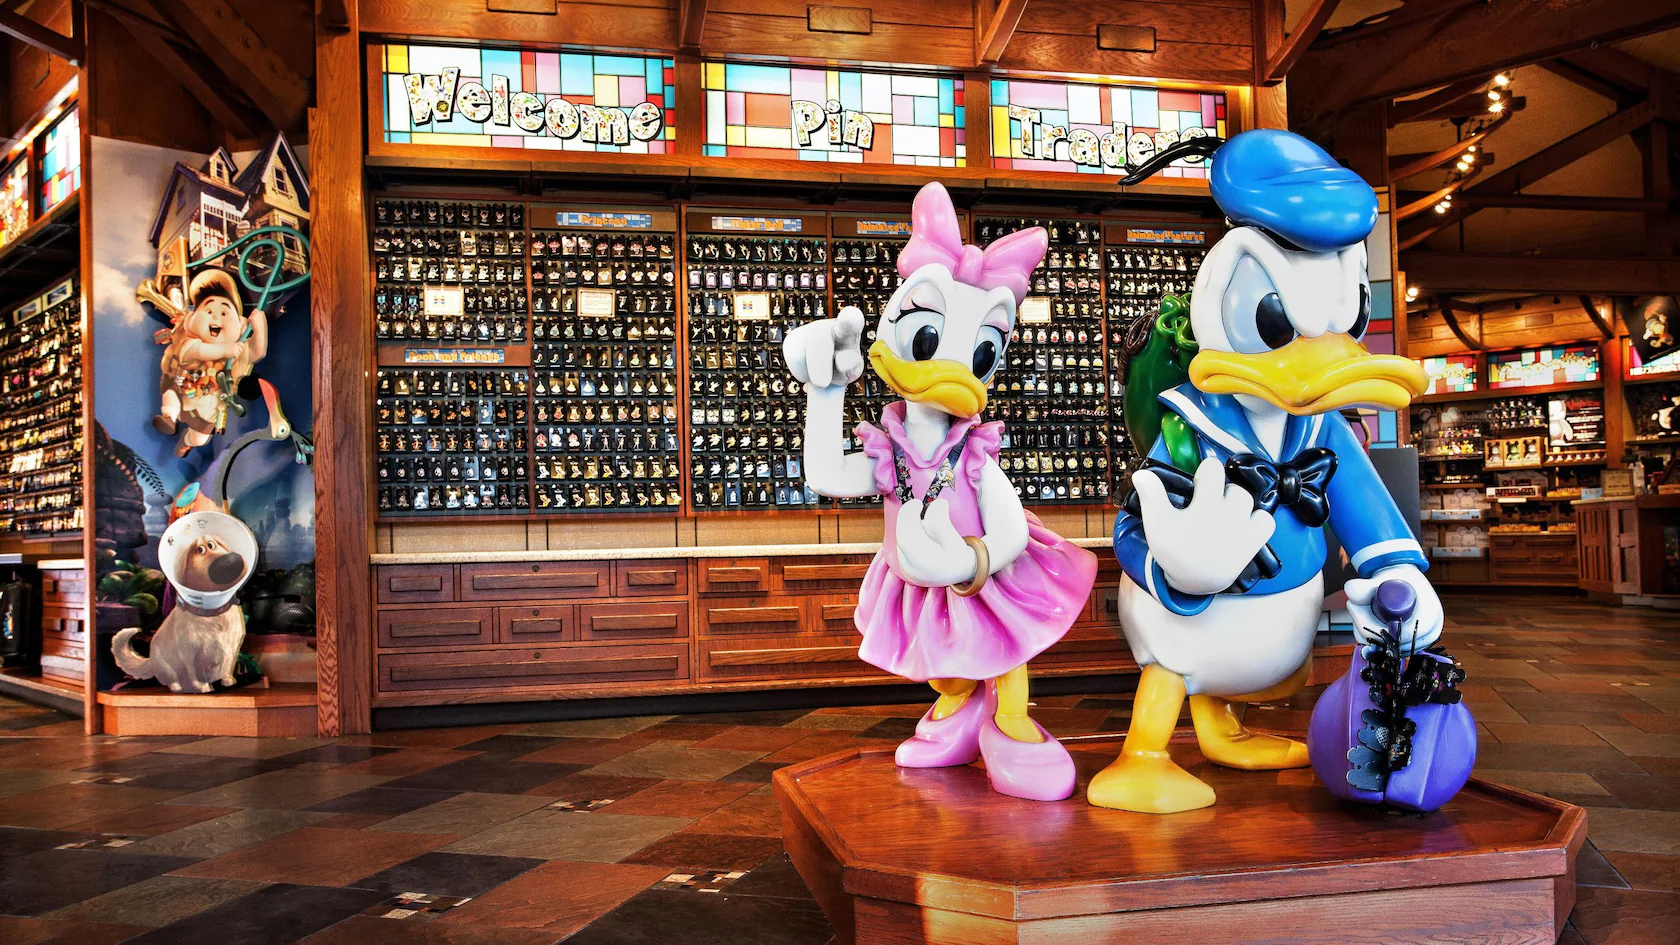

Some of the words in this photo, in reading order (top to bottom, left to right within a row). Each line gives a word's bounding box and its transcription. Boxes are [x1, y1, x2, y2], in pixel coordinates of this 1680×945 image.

[403, 66, 664, 146] Welcome
[791, 98, 875, 151] Pin
[581, 214, 629, 226] Princess
[408, 350, 436, 361] Pooh
[438, 350, 458, 361] and
[460, 350, 500, 361] Friends
